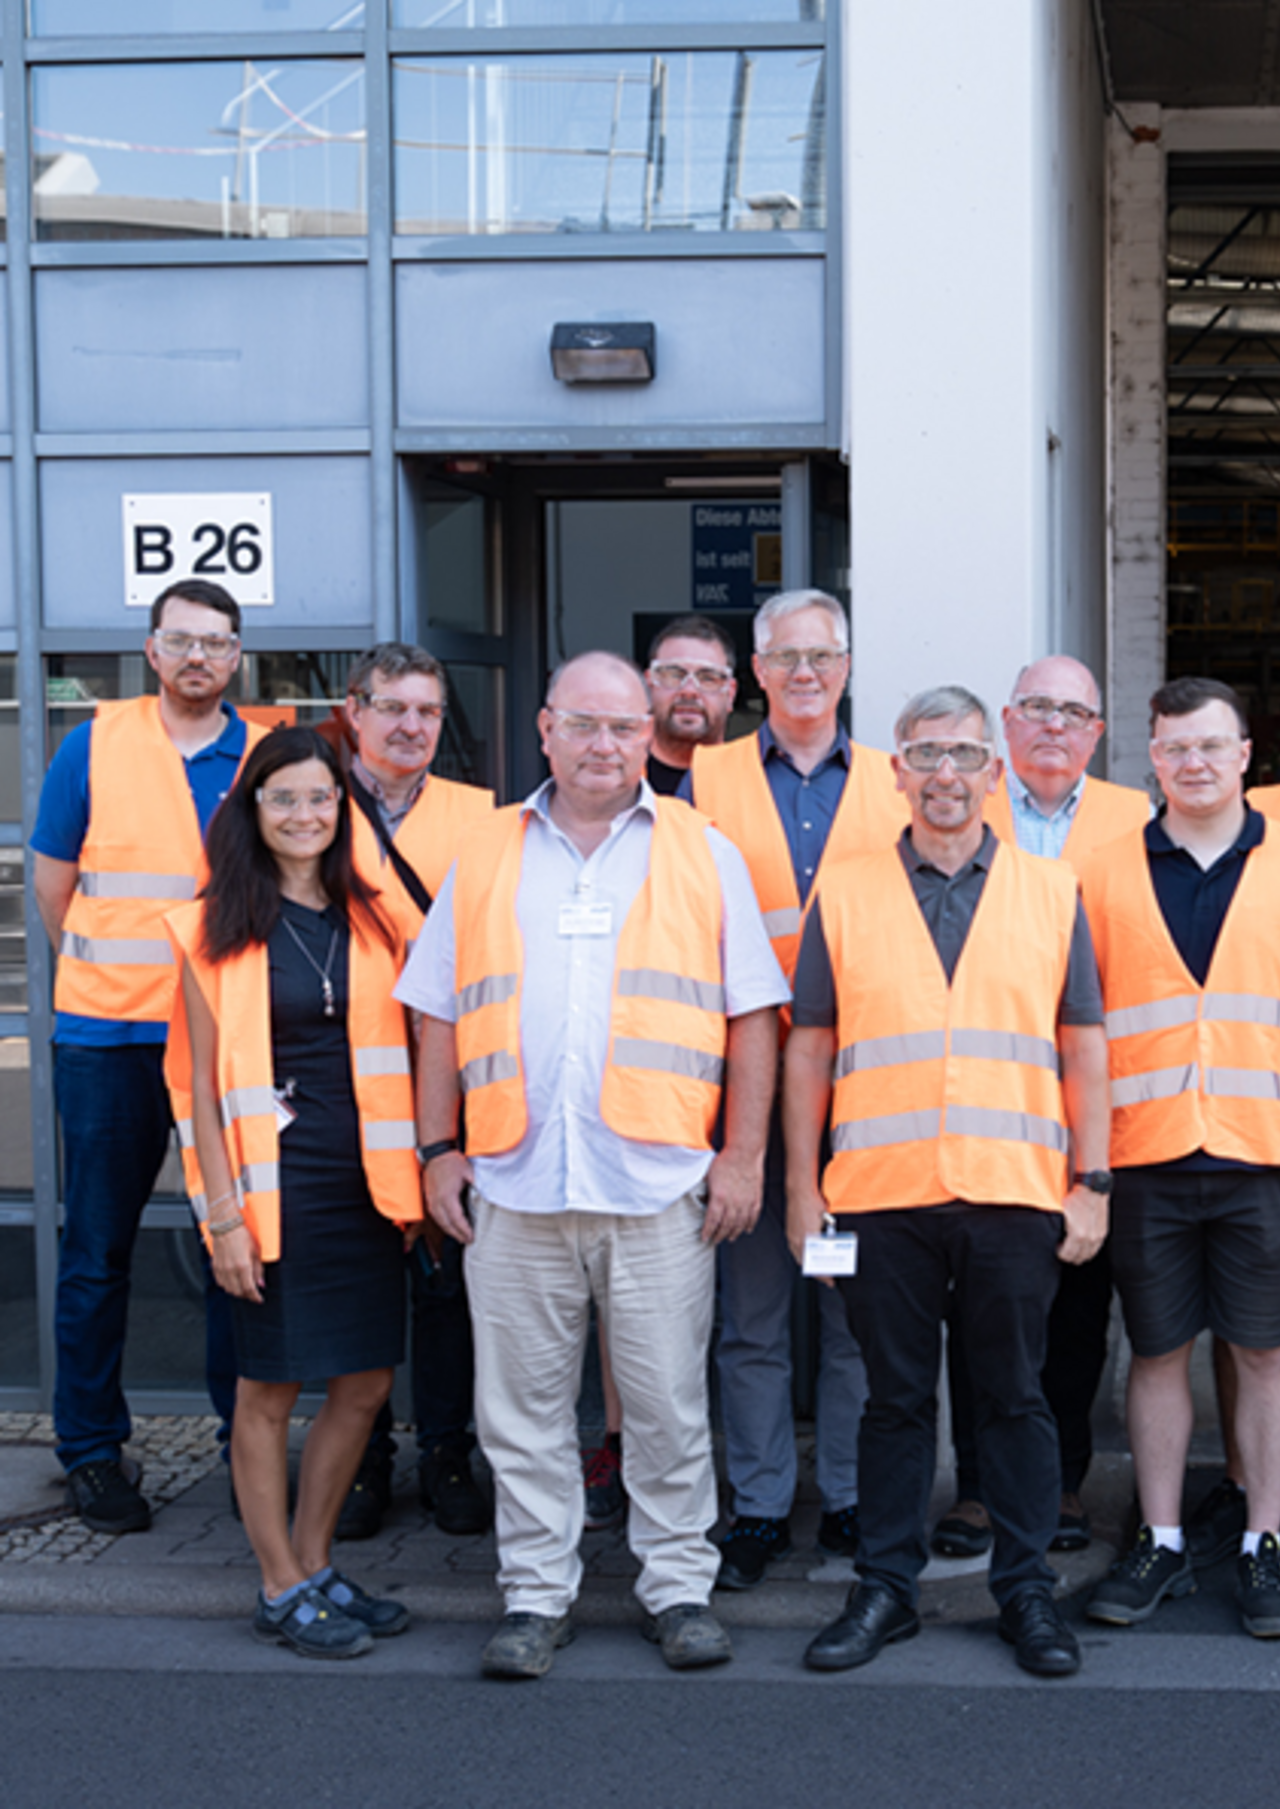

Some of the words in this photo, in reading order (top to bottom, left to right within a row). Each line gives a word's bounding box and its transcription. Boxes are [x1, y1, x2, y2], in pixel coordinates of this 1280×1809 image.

[696, 507, 742, 527] Diese
[134, 525, 174, 574] B
[192, 523, 262, 574] 26
